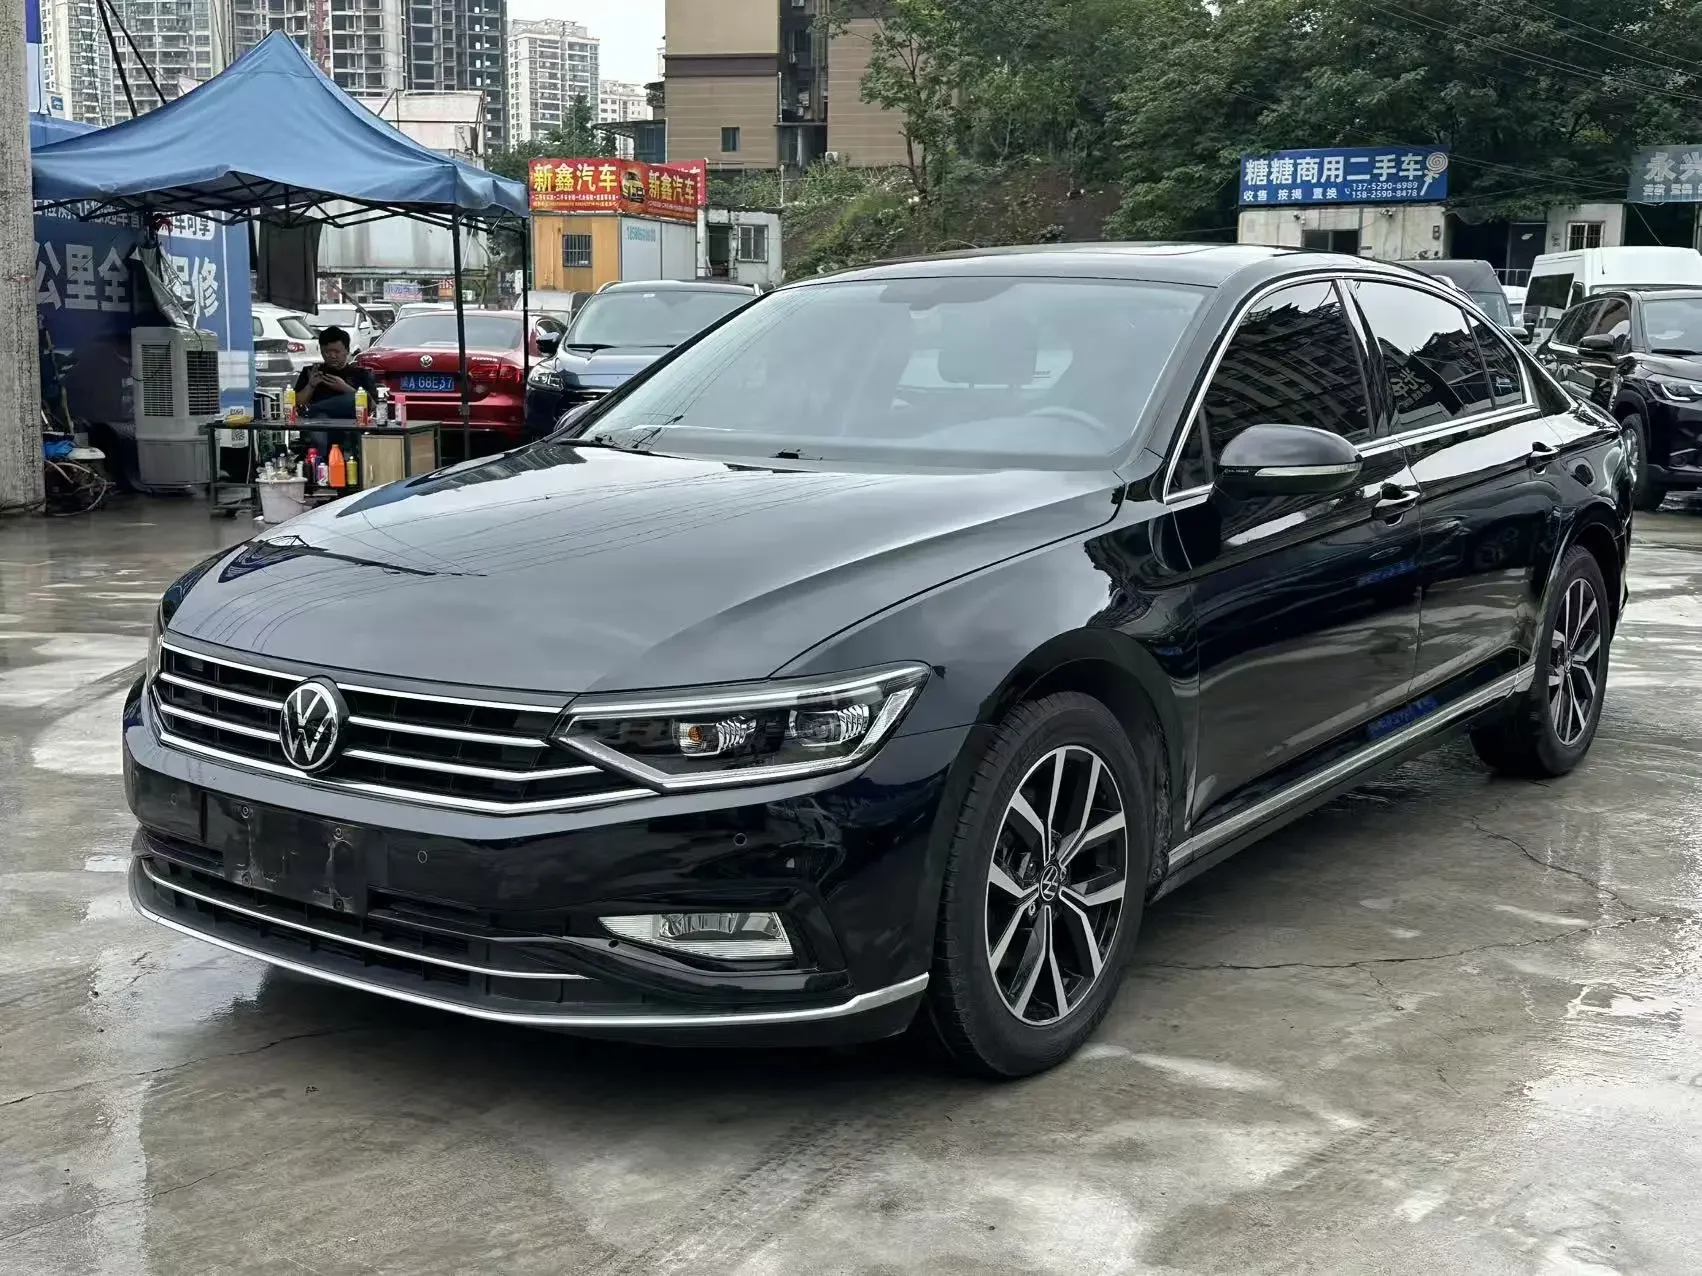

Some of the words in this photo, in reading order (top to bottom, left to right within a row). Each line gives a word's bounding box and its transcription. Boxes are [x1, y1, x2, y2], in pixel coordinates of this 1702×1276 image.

[533, 162, 618, 192] 新鑫汽车
[1244, 153, 1423, 186] 糖糖商用二手车
[648, 169, 695, 205] 新鑫汽车
